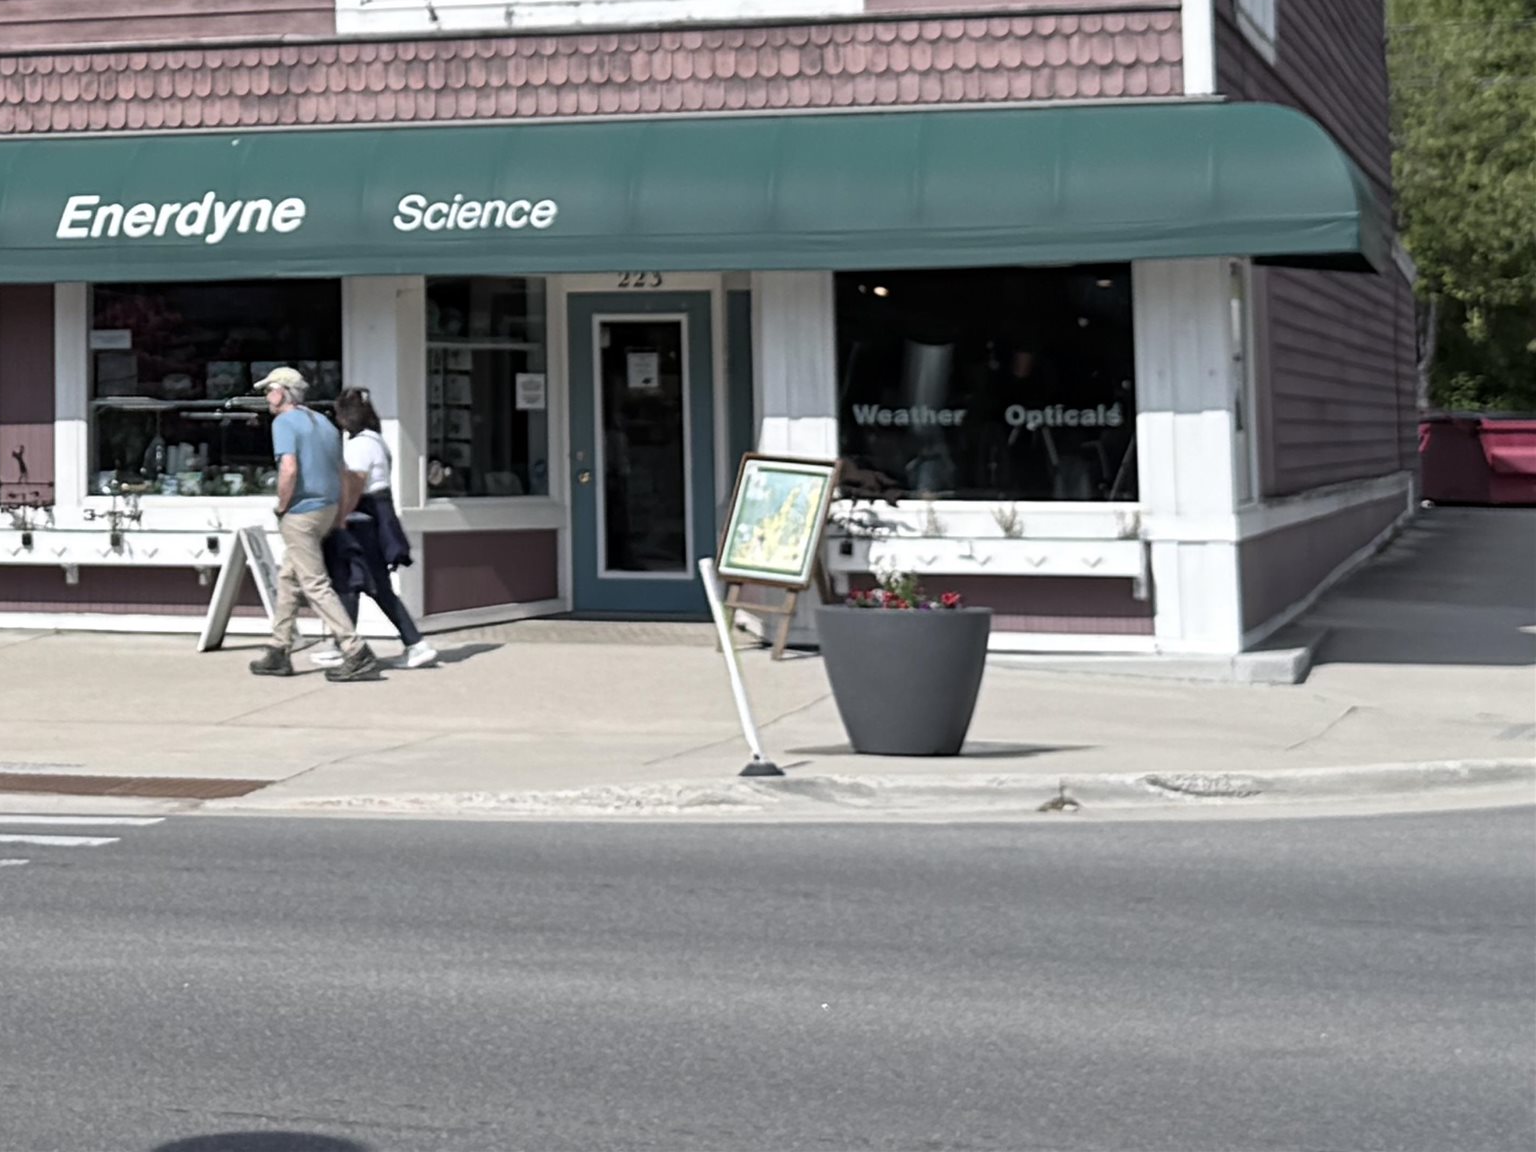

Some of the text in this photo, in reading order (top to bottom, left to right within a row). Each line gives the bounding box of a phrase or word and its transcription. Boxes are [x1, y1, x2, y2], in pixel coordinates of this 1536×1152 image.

[56, 191, 306, 244] Enerdyne
[392, 193, 558, 231] Science
[852, 403, 1124, 430] Weather Opticals
